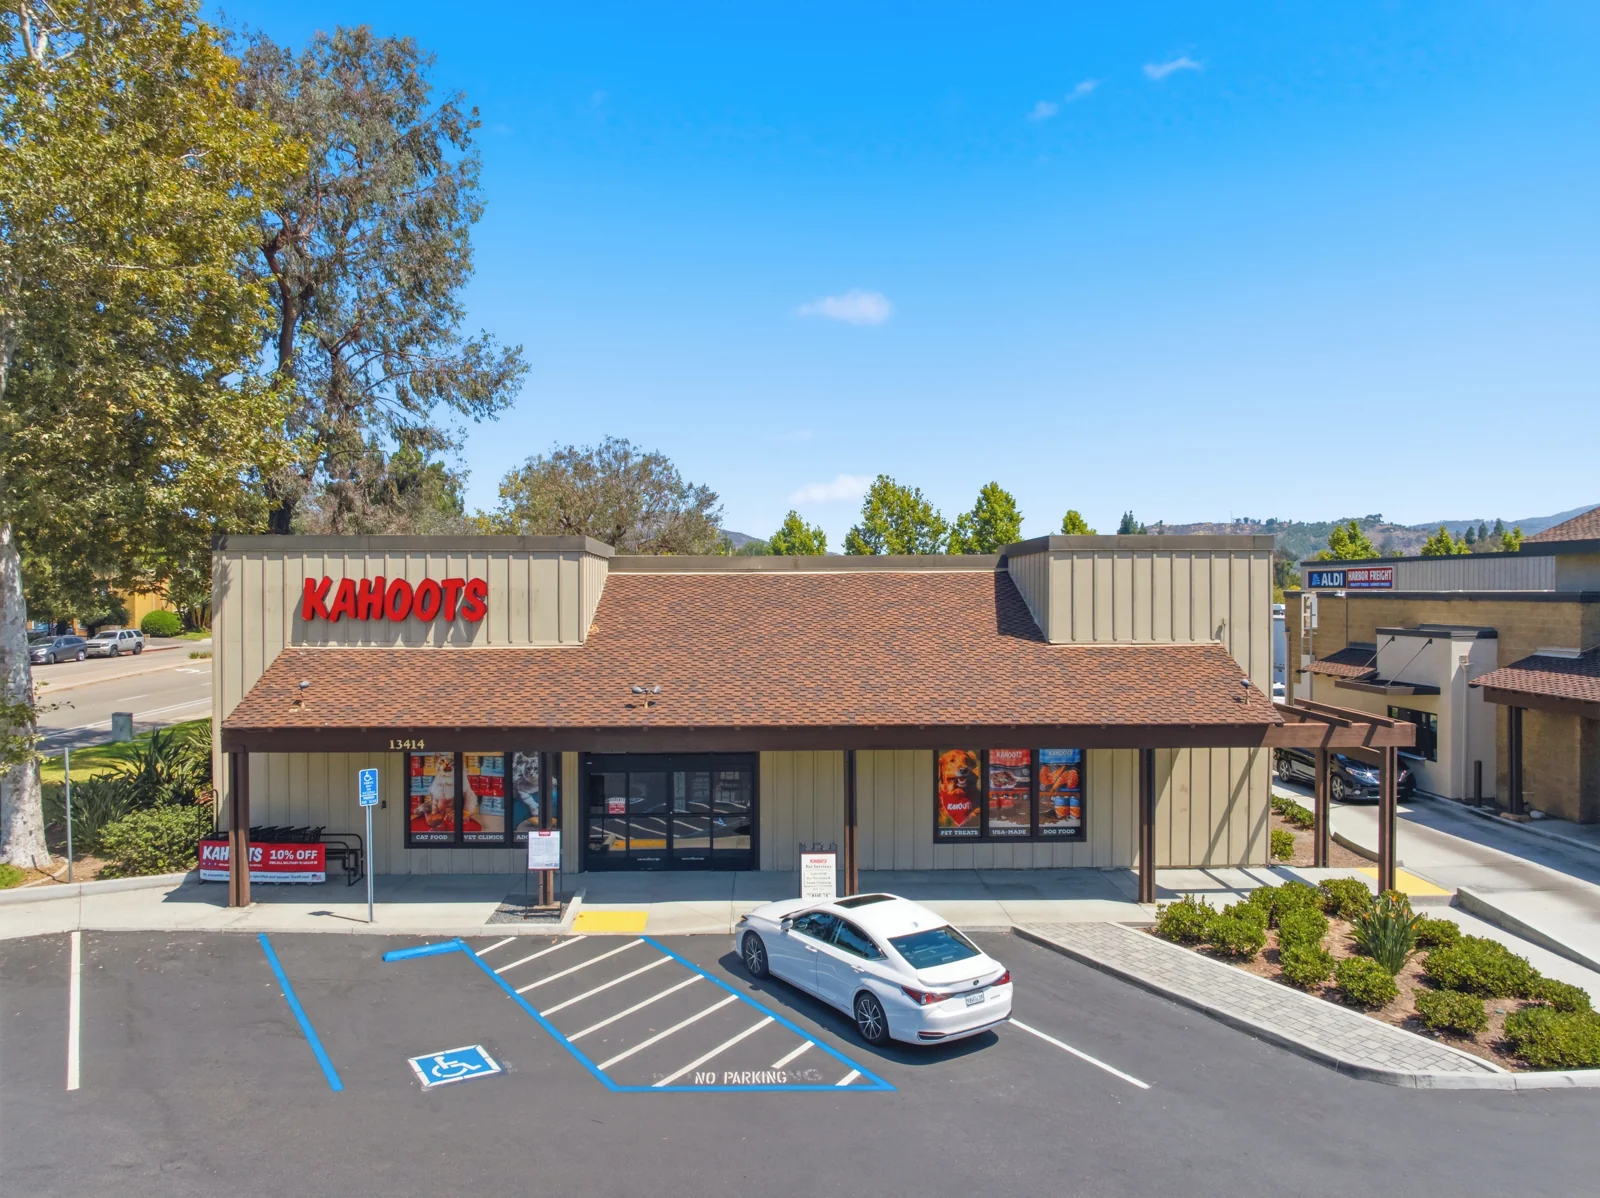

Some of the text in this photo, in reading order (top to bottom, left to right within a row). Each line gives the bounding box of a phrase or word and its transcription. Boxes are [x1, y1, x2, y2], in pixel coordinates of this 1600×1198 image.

[1321, 573, 1343, 586] ALDI
[1348, 570, 1392, 581] HARBOR FREIGHT
[302, 575, 488, 623] KAHOOTS
[389, 739, 425, 749] 13414
[203, 845, 263, 862] KAHTS
[270, 850, 318, 860] 10% OFF
[694, 1071, 716, 1085] NO
[723, 1070, 787, 1084] PARKING
